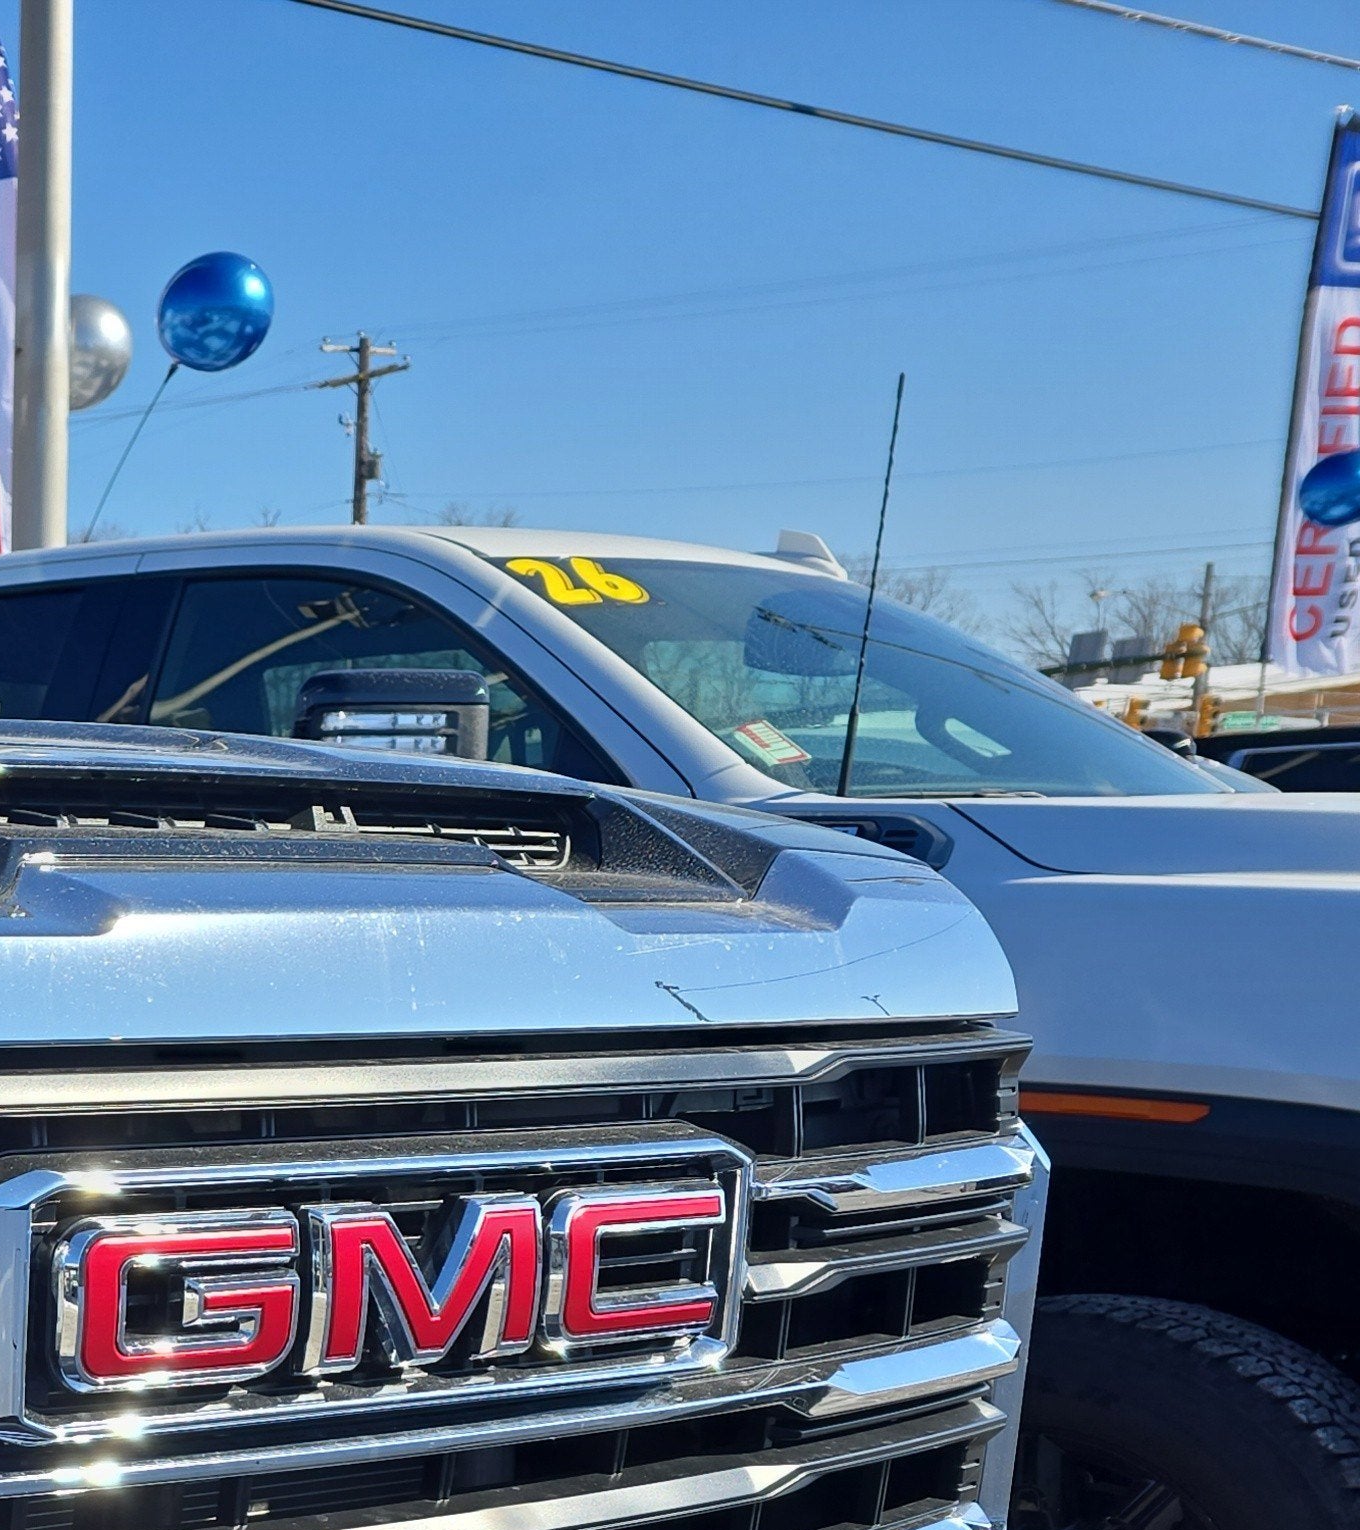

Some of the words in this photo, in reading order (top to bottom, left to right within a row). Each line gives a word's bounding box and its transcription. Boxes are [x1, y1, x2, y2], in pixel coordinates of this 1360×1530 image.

[505, 557, 651, 605] 26
[1289, 316, 1360, 642] CERFIED
[55, 1179, 726, 1394] GMC
